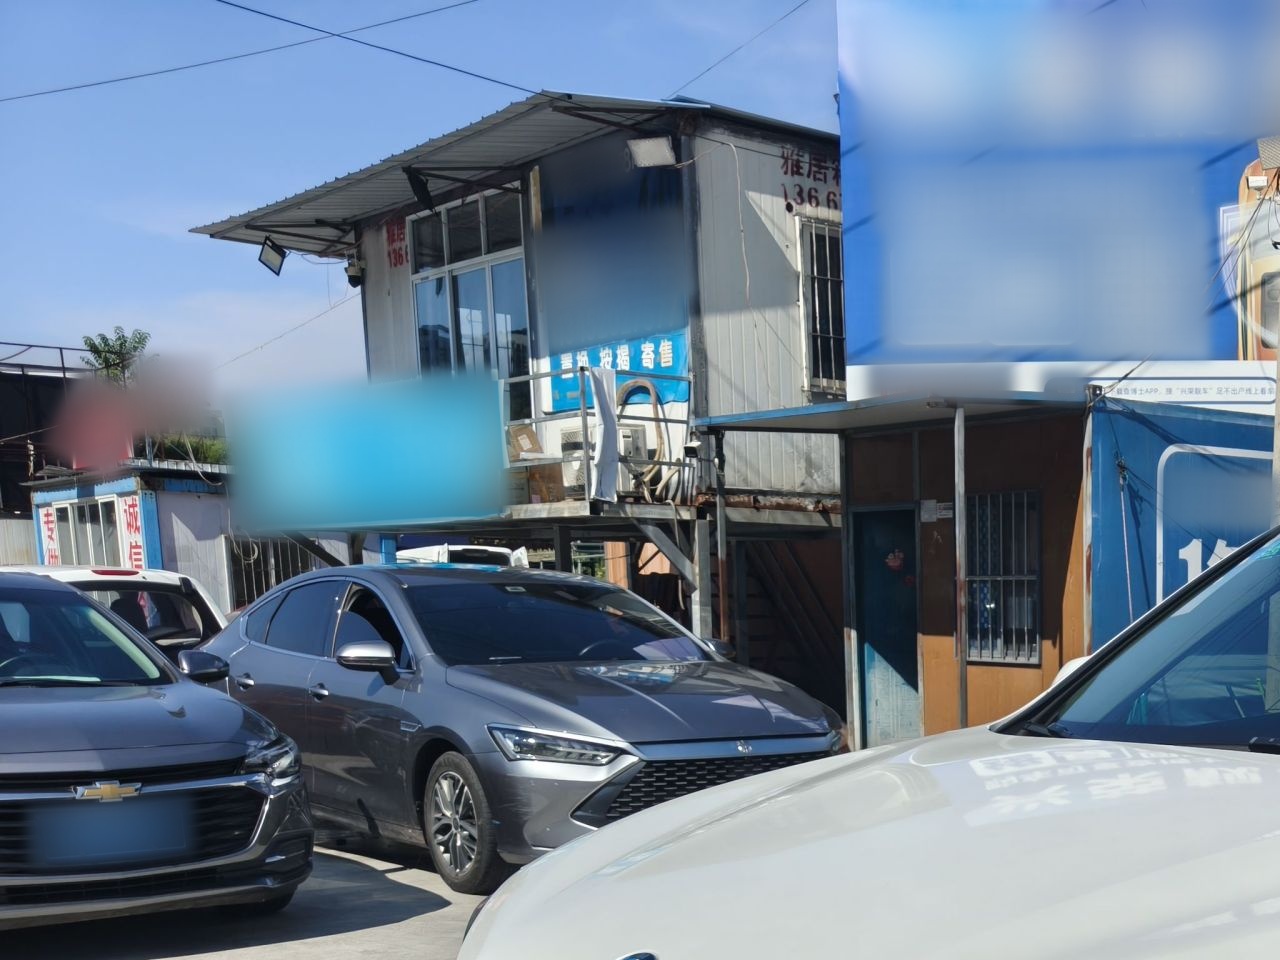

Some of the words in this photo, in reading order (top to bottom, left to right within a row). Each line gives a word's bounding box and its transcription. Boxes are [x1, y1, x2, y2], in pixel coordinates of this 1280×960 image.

[781, 183, 842, 211] 1366
[641, 339, 673, 369] 寄售
[124, 496, 143, 569] 诚信
